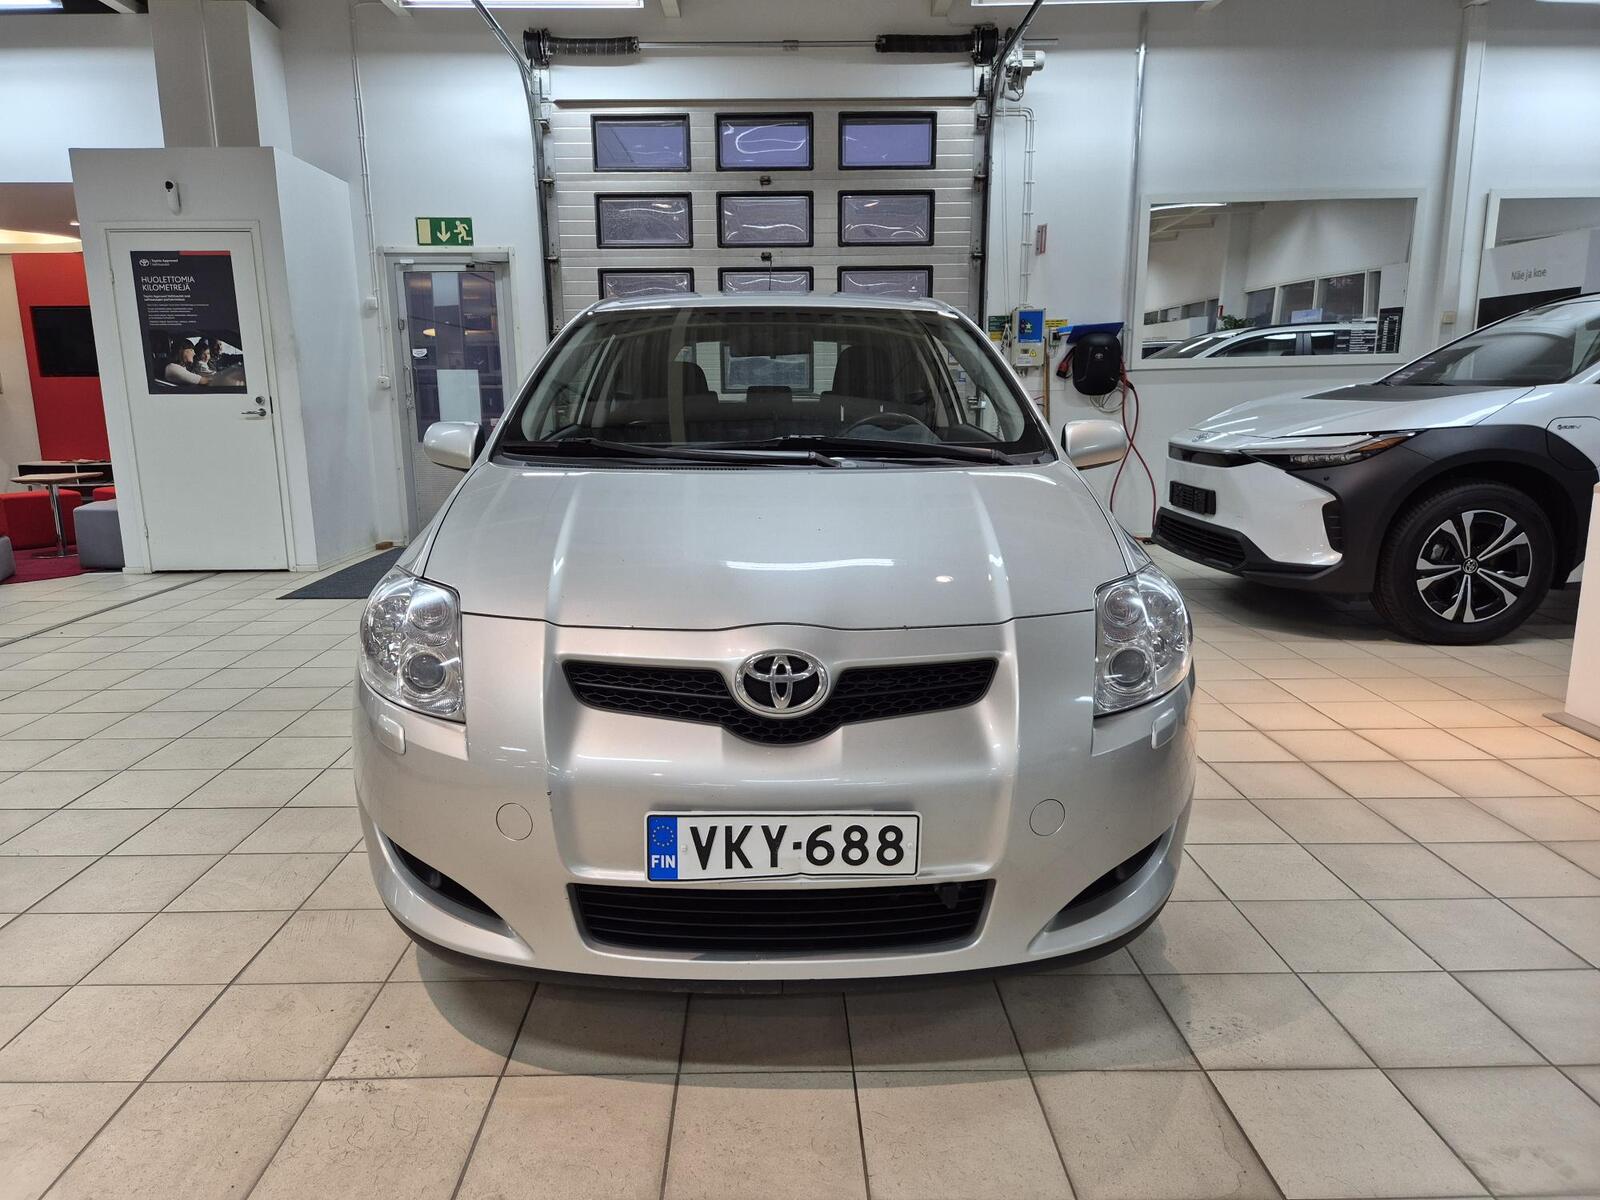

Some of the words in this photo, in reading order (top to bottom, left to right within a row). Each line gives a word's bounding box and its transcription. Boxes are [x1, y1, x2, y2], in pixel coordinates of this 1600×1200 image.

[142, 283, 191, 291] KILOMETREJÄ
[689, 825, 904, 870] VKY-688
[651, 855, 676, 868] FIN
